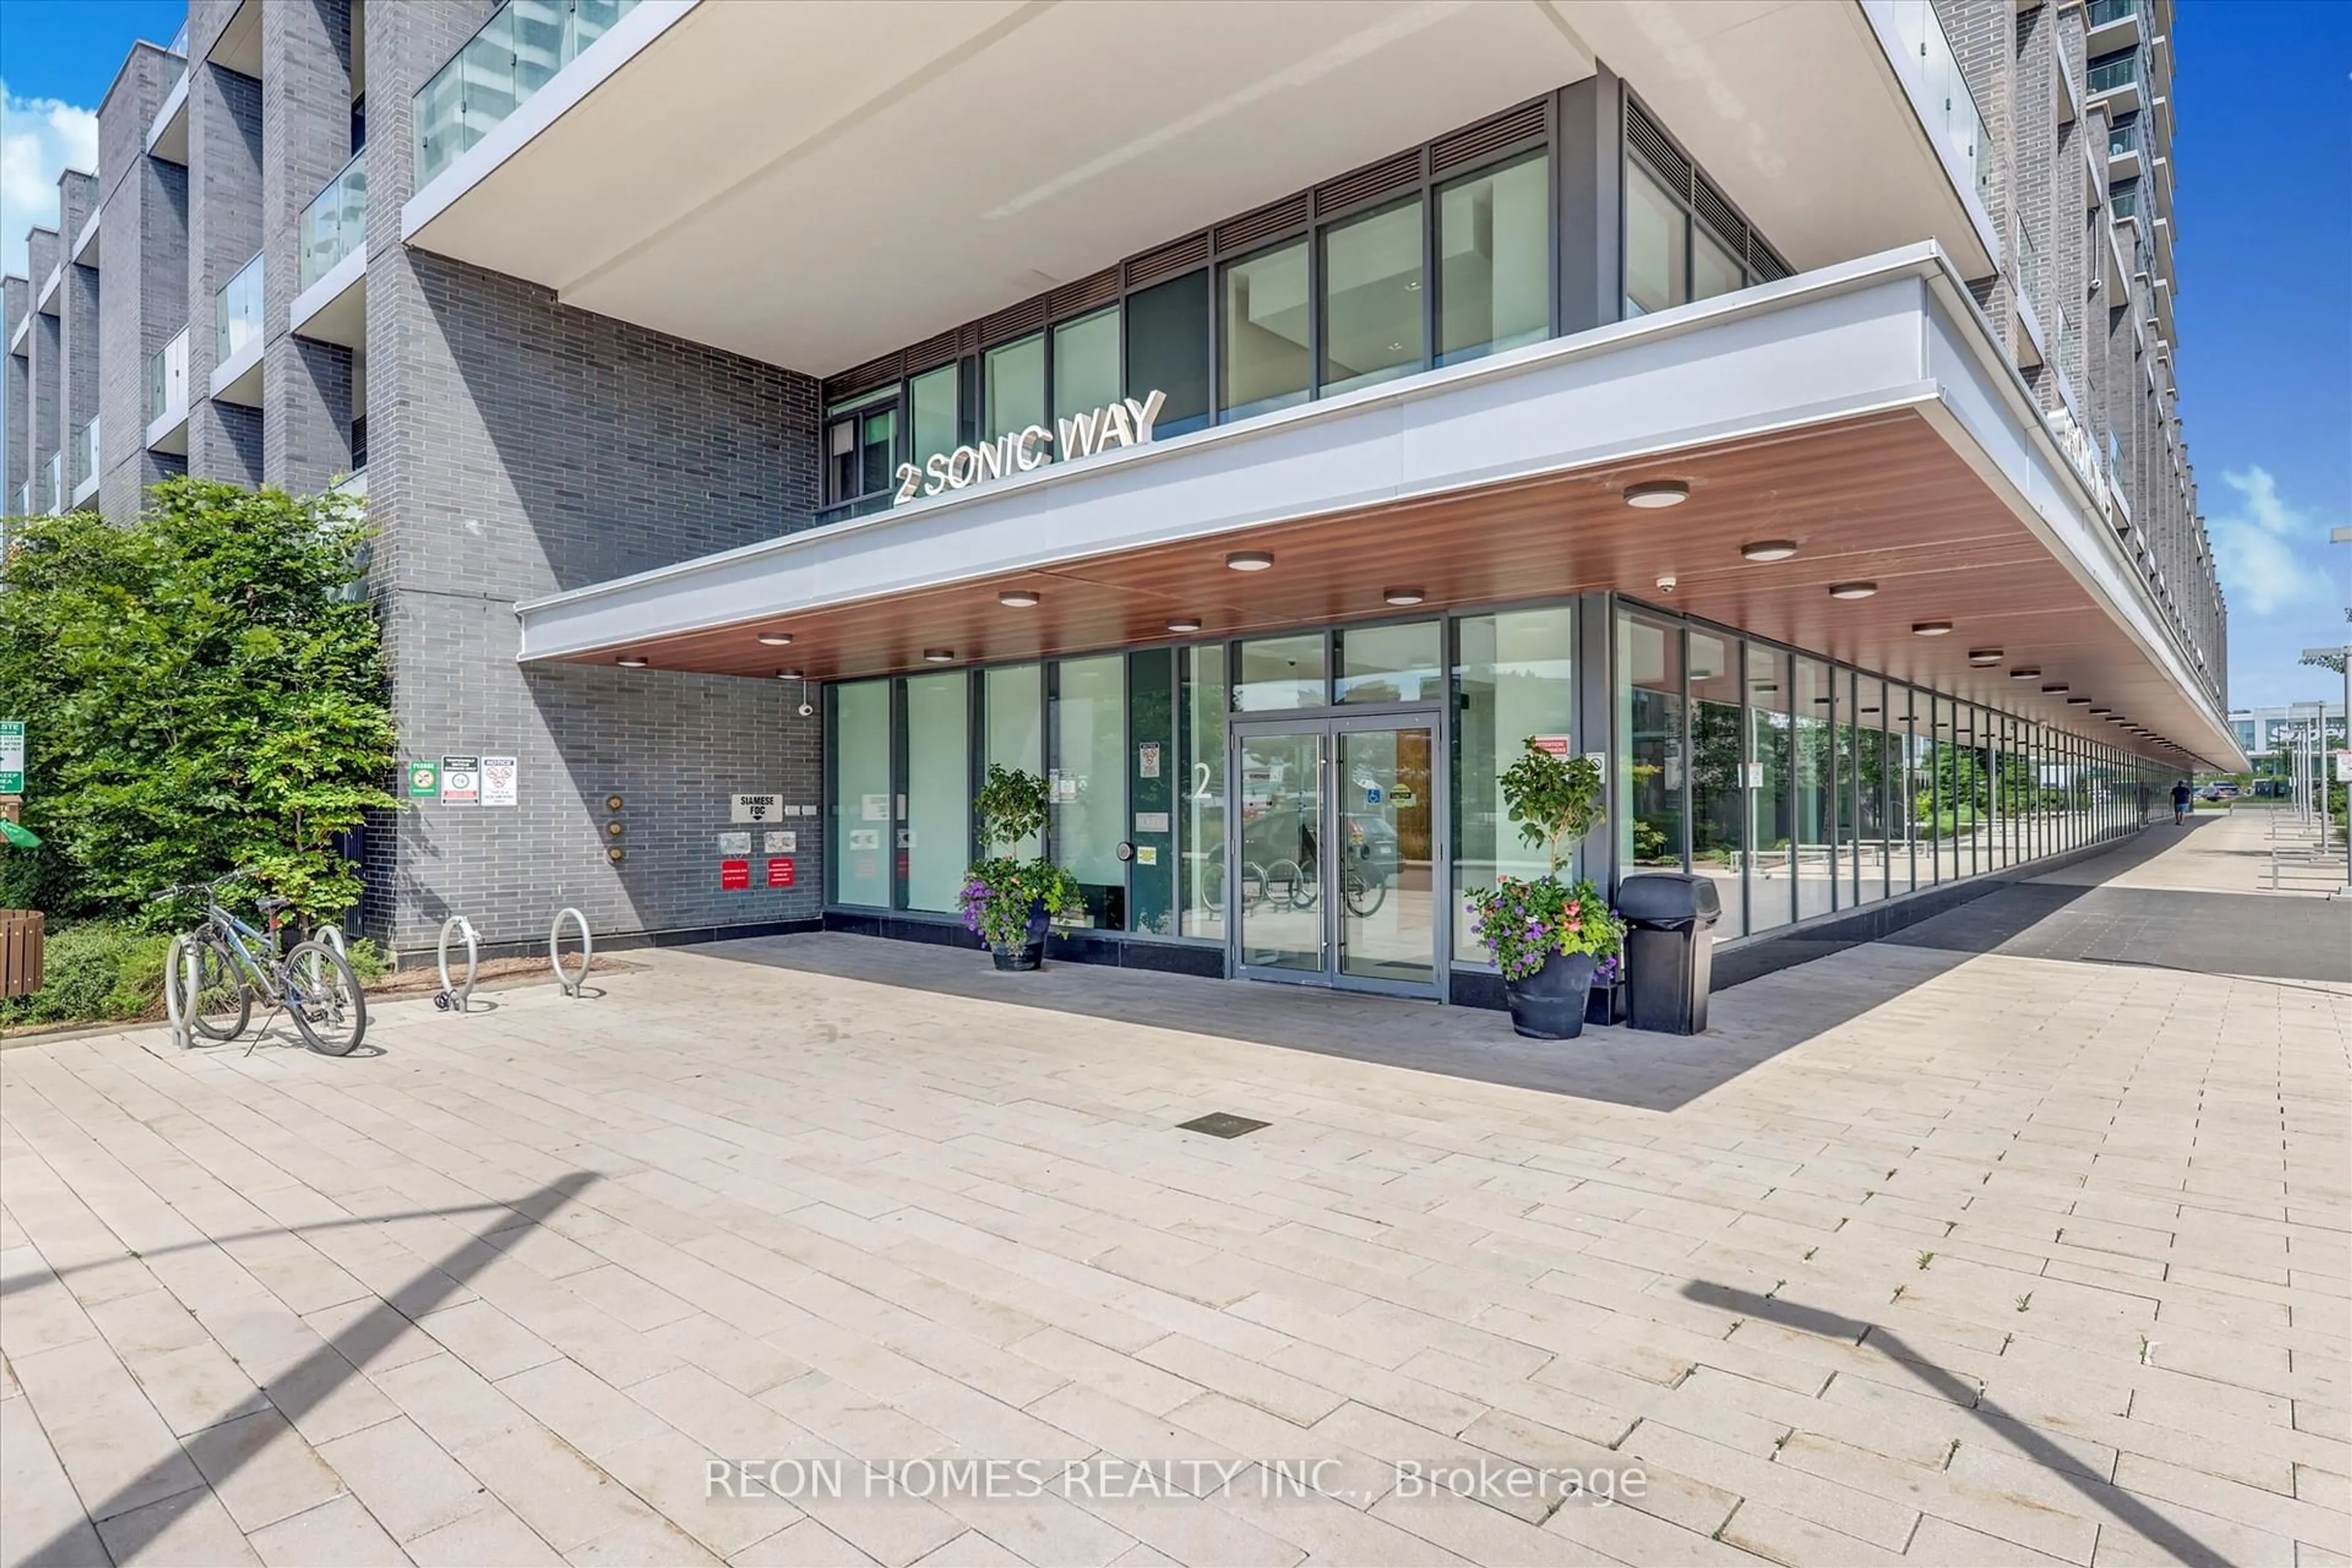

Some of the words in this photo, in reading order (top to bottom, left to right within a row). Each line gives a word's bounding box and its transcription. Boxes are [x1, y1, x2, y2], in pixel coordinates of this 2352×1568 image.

[894, 462, 922, 505] 2
[924, 424, 1053, 496] SONIC
[1058, 390, 1166, 461] WAY
[1194, 763, 1212, 798] 2
[741, 796, 774, 805] SIAMESE
